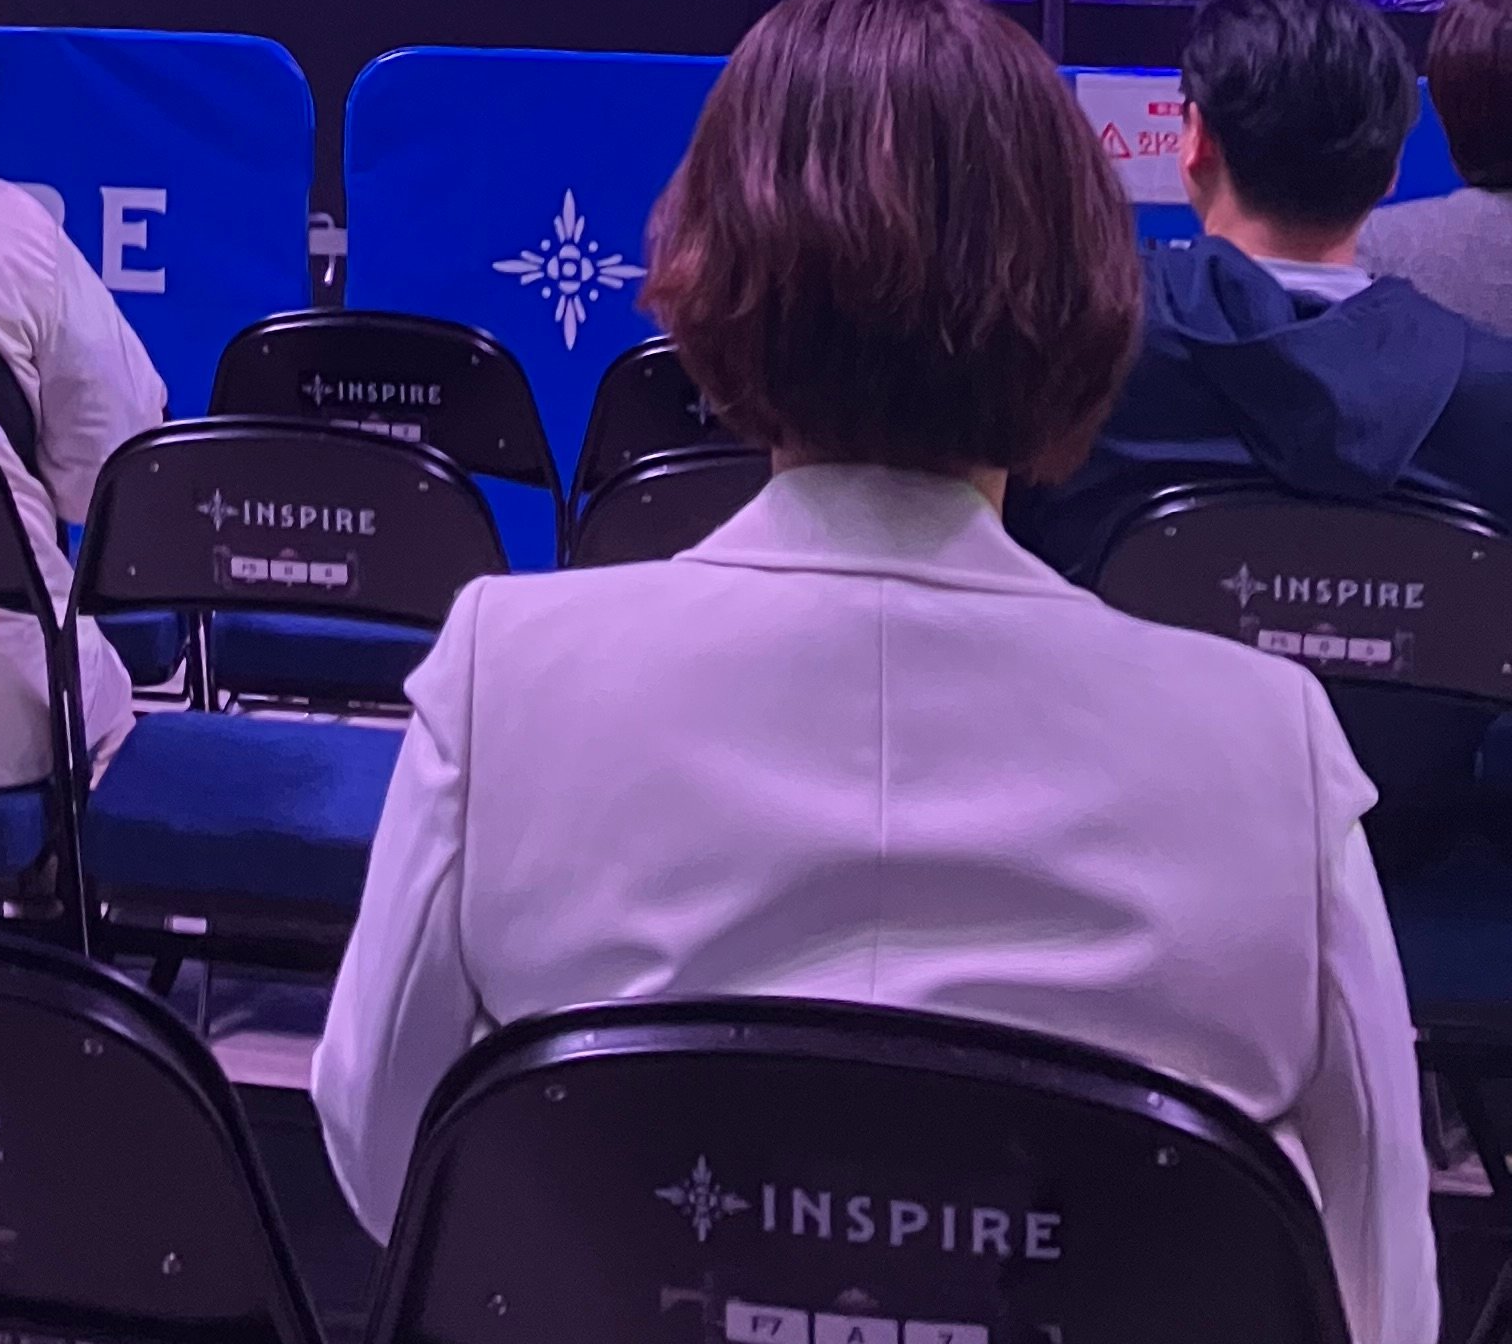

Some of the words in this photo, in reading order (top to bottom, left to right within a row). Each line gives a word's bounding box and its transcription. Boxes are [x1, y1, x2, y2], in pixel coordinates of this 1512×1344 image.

[338, 380, 441, 405] INSPIRE
[243, 499, 376, 536] INSPIRE
[1273, 573, 1425, 609] INSPIRE
[762, 1182, 1062, 1260] INSPIRE
